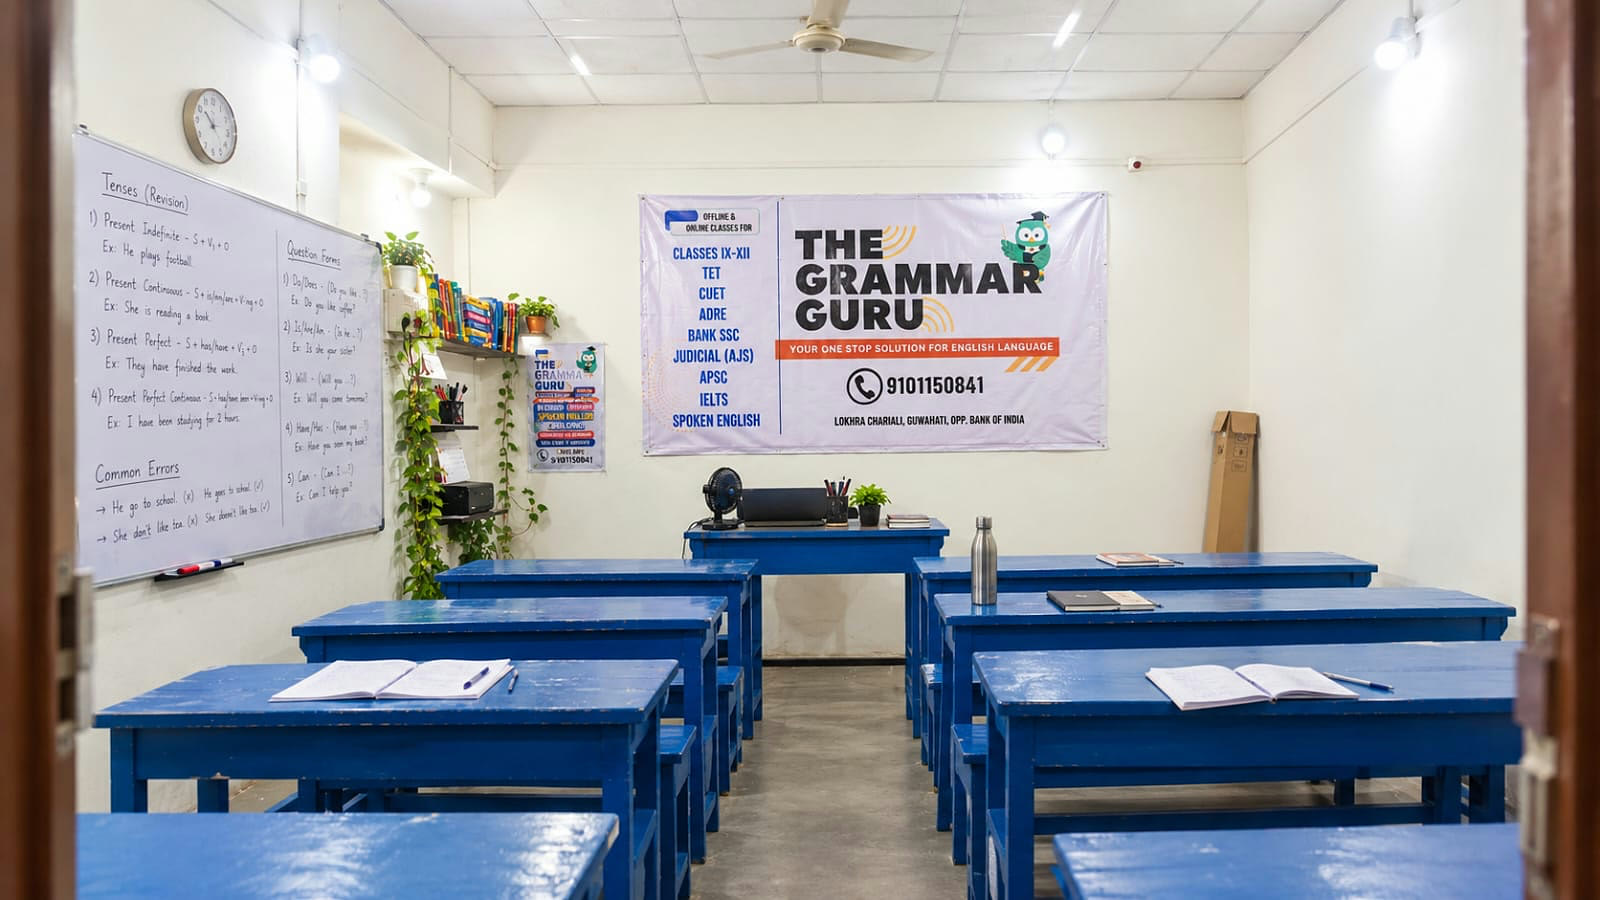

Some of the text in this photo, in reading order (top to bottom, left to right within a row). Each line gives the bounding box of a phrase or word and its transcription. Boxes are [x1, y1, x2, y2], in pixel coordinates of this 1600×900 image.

[101, 171, 189, 213] Tenses (Revision)
[703, 212, 736, 221] OFFLINE &
[89, 208, 98, 228] 1)
[104, 211, 135, 232] Present
[143, 221, 180, 242] Indefinite
[685, 223, 752, 232] ONLINE CLASSES FOR
[287, 239, 341, 266] Question Forms
[795, 229, 883, 260] THE
[103, 239, 117, 253] Ex:
[123, 242, 134, 257] He
[140, 247, 160, 267] plays
[673, 247, 750, 260] CLASSES IX-XII
[89, 268, 99, 288] 2)
[105, 270, 136, 290] Present
[702, 266, 721, 280] TET
[795, 262, 1042, 296] GRAMMAR
[698, 287, 726, 300] CUET
[104, 297, 118, 311] Ex:
[124, 300, 139, 315] She
[145, 305, 151, 315] is
[156, 305, 182, 326] reading
[699, 307, 727, 321] ADRE
[795, 298, 924, 331] GURU
[283, 319, 291, 335] 2)
[687, 328, 740, 342] BANK SSC
[90, 327, 101, 346] 3)
[107, 328, 137, 346] Present
[145, 332, 172, 350] Perfect
[186, 337, 191, 349] S
[200, 338, 229, 354] has/have
[789, 342, 1054, 354] YOUR ONE STOP SOLUTION FOR ENGLISH LANGUAGE
[673, 348, 754, 364] JUDICIAL (AJS)
[105, 355, 120, 369] Ex:
[125, 356, 145, 378] They
[152, 359, 169, 371] have
[175, 358, 201, 377] finished
[206, 362, 217, 373] the
[534, 360, 556, 370] THE
[284, 369, 292, 384] 3)
[699, 370, 728, 384] APSC
[534, 380, 565, 390] GURU
[886, 376, 984, 395] 9101150841
[91, 387, 101, 407] 4)
[108, 388, 137, 403] Present
[143, 389, 166, 407] Perfect
[699, 392, 728, 407] IELTS
[127, 414, 133, 429] I
[138, 414, 154, 427] have
[158, 413, 173, 427] been
[176, 413, 202, 430] studying
[217, 412, 222, 423] 2
[285, 420, 293, 436] 4)
[672, 413, 760, 428] SPOKEN ENGLISH
[834, 415, 1025, 427] LOKHRA CHARIALI, GUWAHATI, OPP. BANK OF INDIA
[95, 459, 180, 483] Common Errors
[287, 471, 294, 487] 5)
[112, 500, 124, 514] He
[129, 503, 139, 518] go
[143, 496, 151, 509] to
[156, 490, 178, 507] school.
[113, 528, 127, 543] She
[133, 522, 152, 539] don't
[157, 520, 169, 534] like
